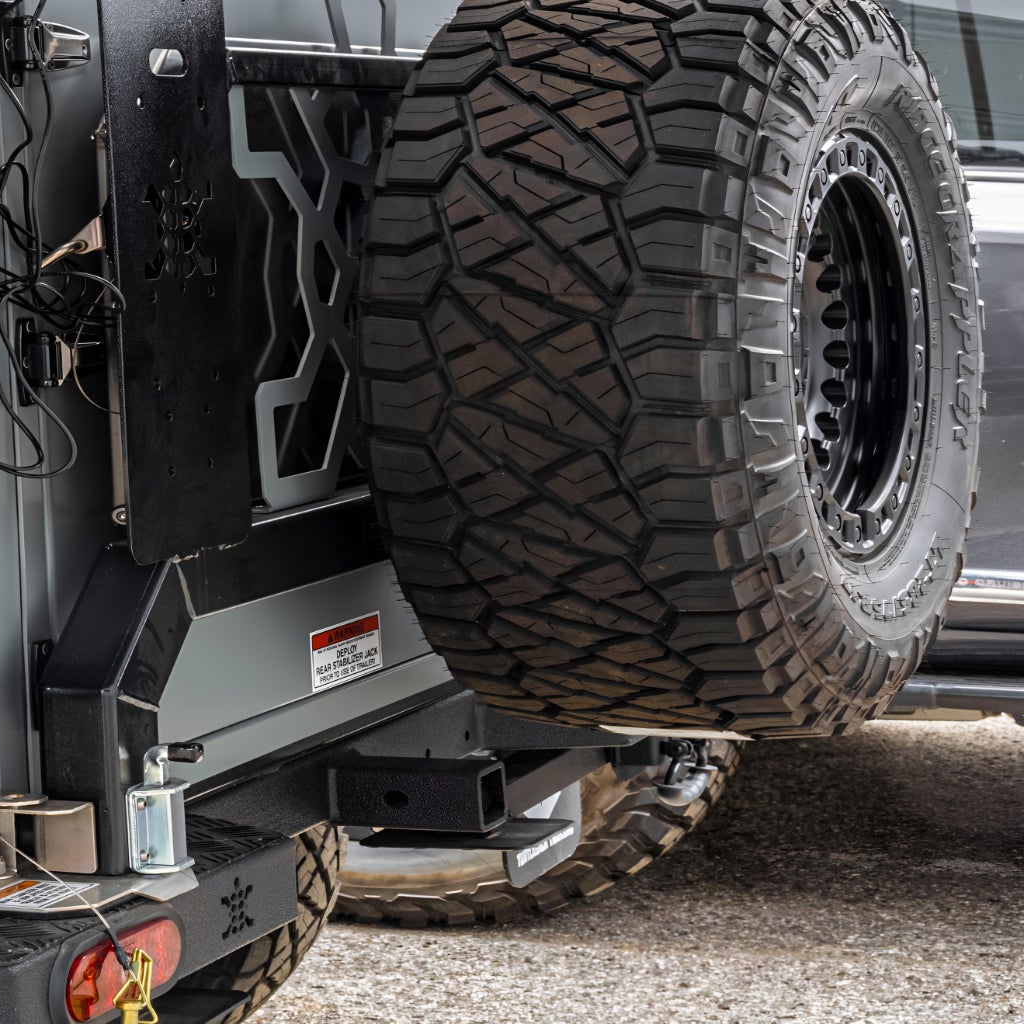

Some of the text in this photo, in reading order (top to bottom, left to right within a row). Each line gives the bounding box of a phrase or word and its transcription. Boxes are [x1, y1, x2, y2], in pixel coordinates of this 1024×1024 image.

[336, 644, 358, 658] DEPLOY
[316, 647, 378, 676] REAR STABILIZER JACK
[319, 674, 333, 683] PRIOR
